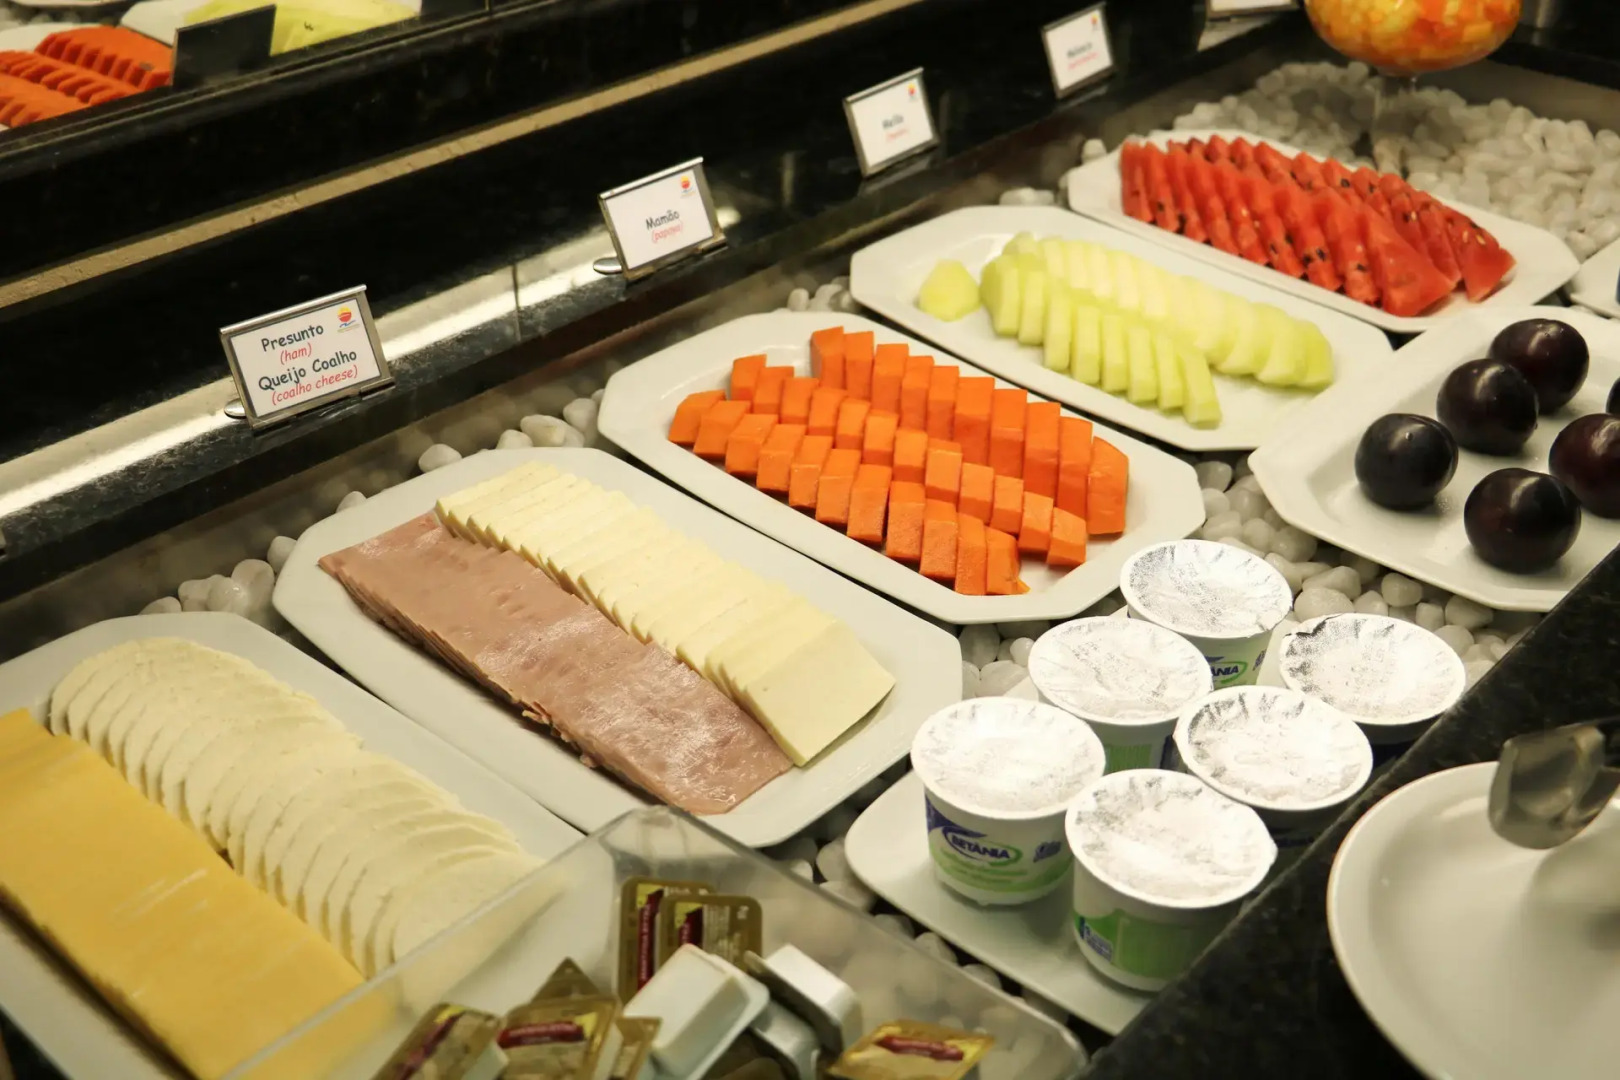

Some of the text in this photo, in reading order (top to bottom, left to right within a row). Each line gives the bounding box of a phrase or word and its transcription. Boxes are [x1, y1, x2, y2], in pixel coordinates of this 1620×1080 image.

[646, 209, 680, 230] Mamão
[261, 325, 324, 352] Presunto
[280, 342, 312, 365] (ham)
[258, 350, 357, 391] Queijo Coalho
[271, 364, 358, 406] (coalho cheese)
